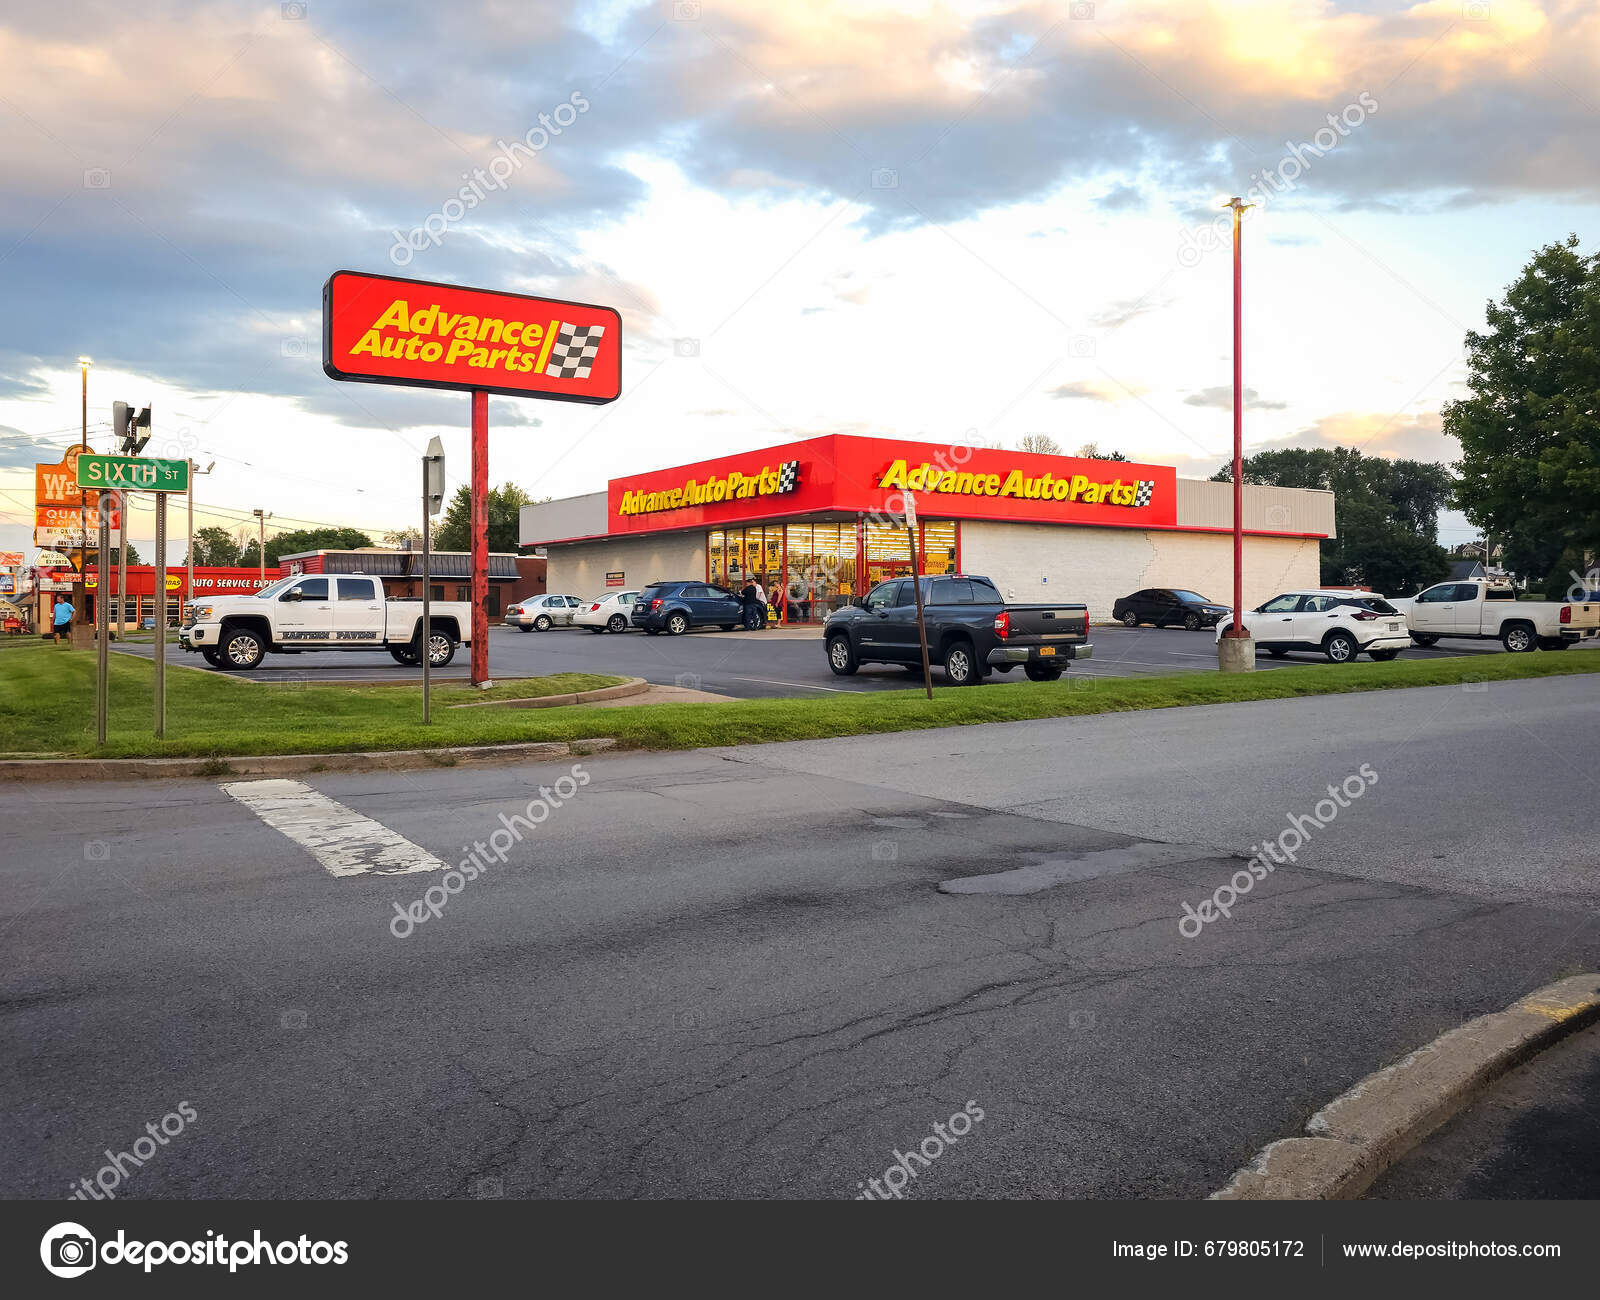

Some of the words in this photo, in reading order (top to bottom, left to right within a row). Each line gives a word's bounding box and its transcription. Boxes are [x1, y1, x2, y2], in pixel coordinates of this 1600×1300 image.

[371, 299, 544, 347] Advance
[349, 329, 443, 362] Auto
[444, 338, 536, 374] Parts
[88, 462, 157, 483] SIXTH
[165, 470, 179, 480] ST
[217, 579, 250, 588] SERVICE
